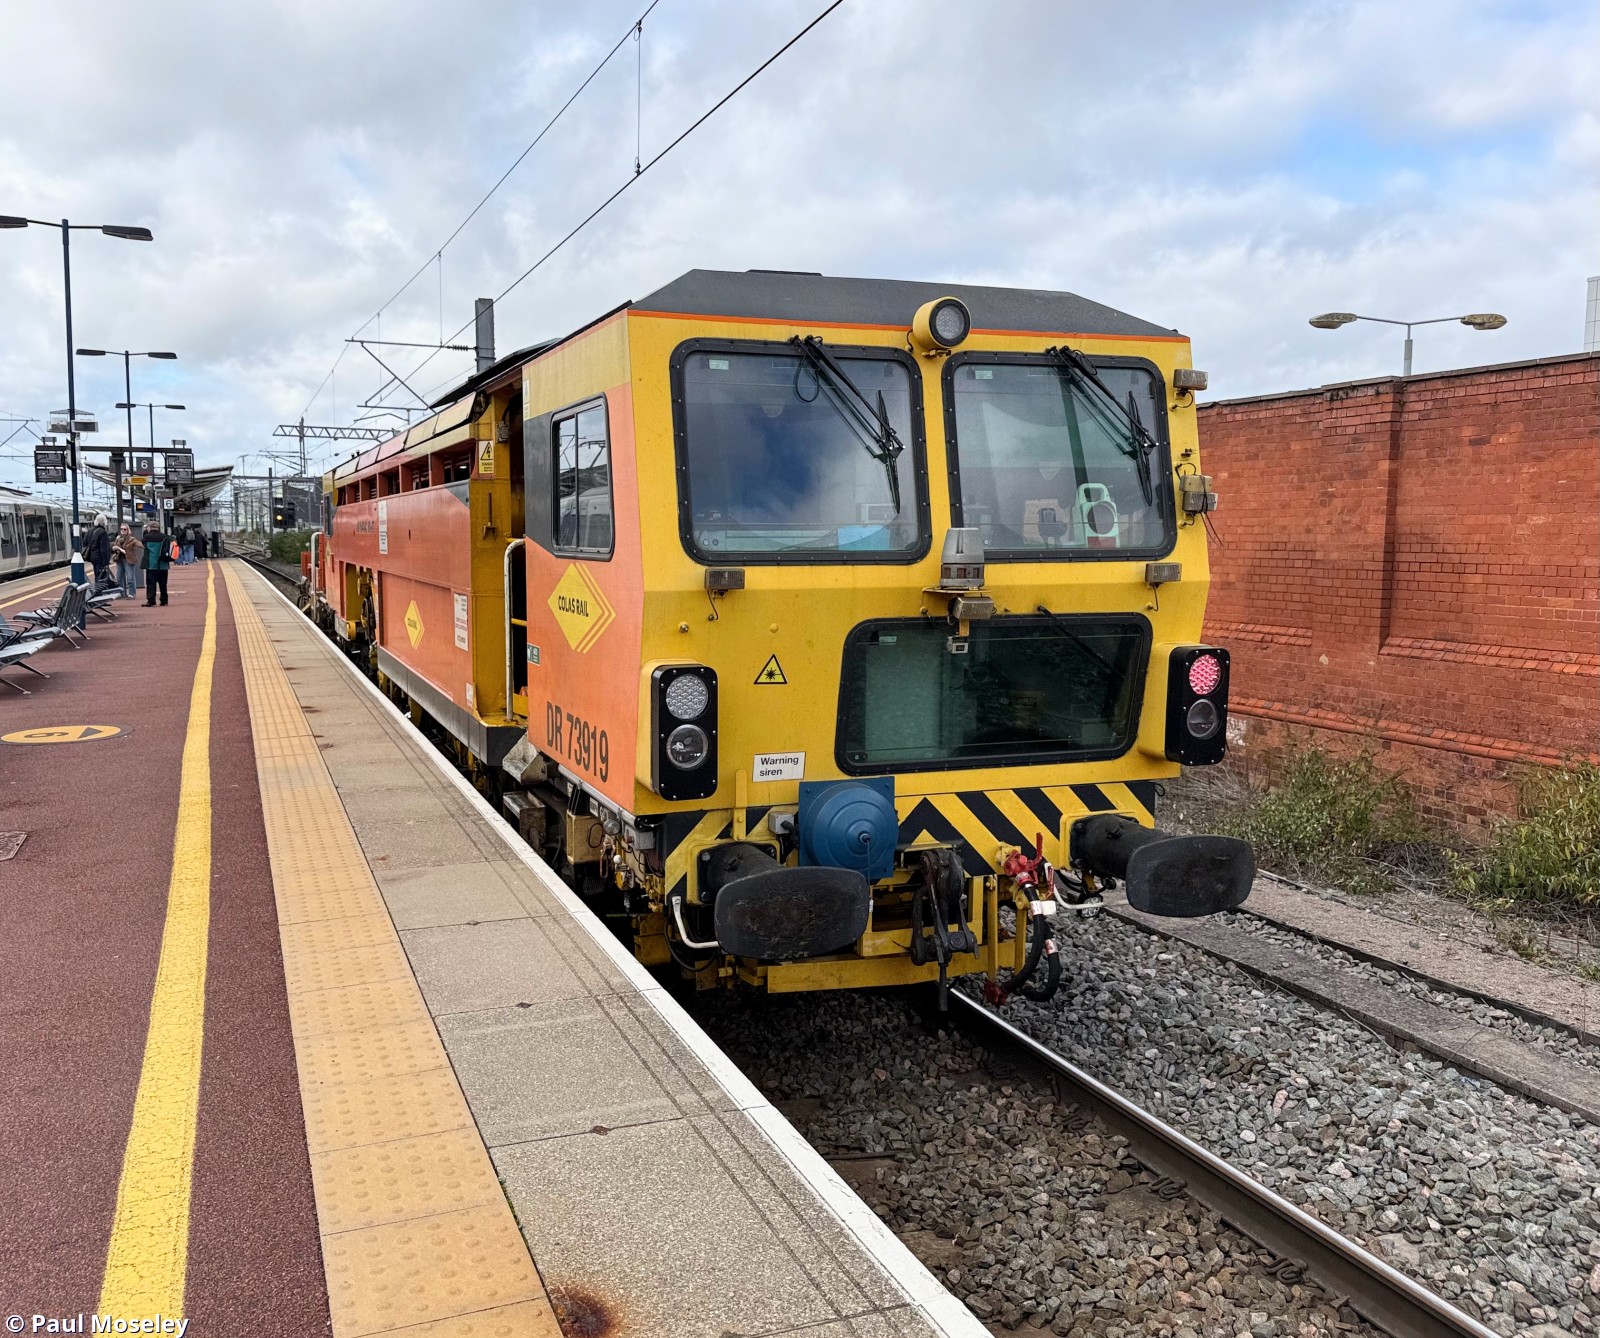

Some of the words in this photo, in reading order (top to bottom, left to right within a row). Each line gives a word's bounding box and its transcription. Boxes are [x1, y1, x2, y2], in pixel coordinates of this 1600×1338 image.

[141, 460, 148, 469] 6
[165, 500, 172, 508] 6
[558, 595, 576, 614] COLAS
[576, 599, 589, 617] RAIL
[546, 700, 563, 755] DR
[567, 712, 609, 783] 73919
[760, 756, 799, 765] Warning
[759, 768, 783, 776] siren
